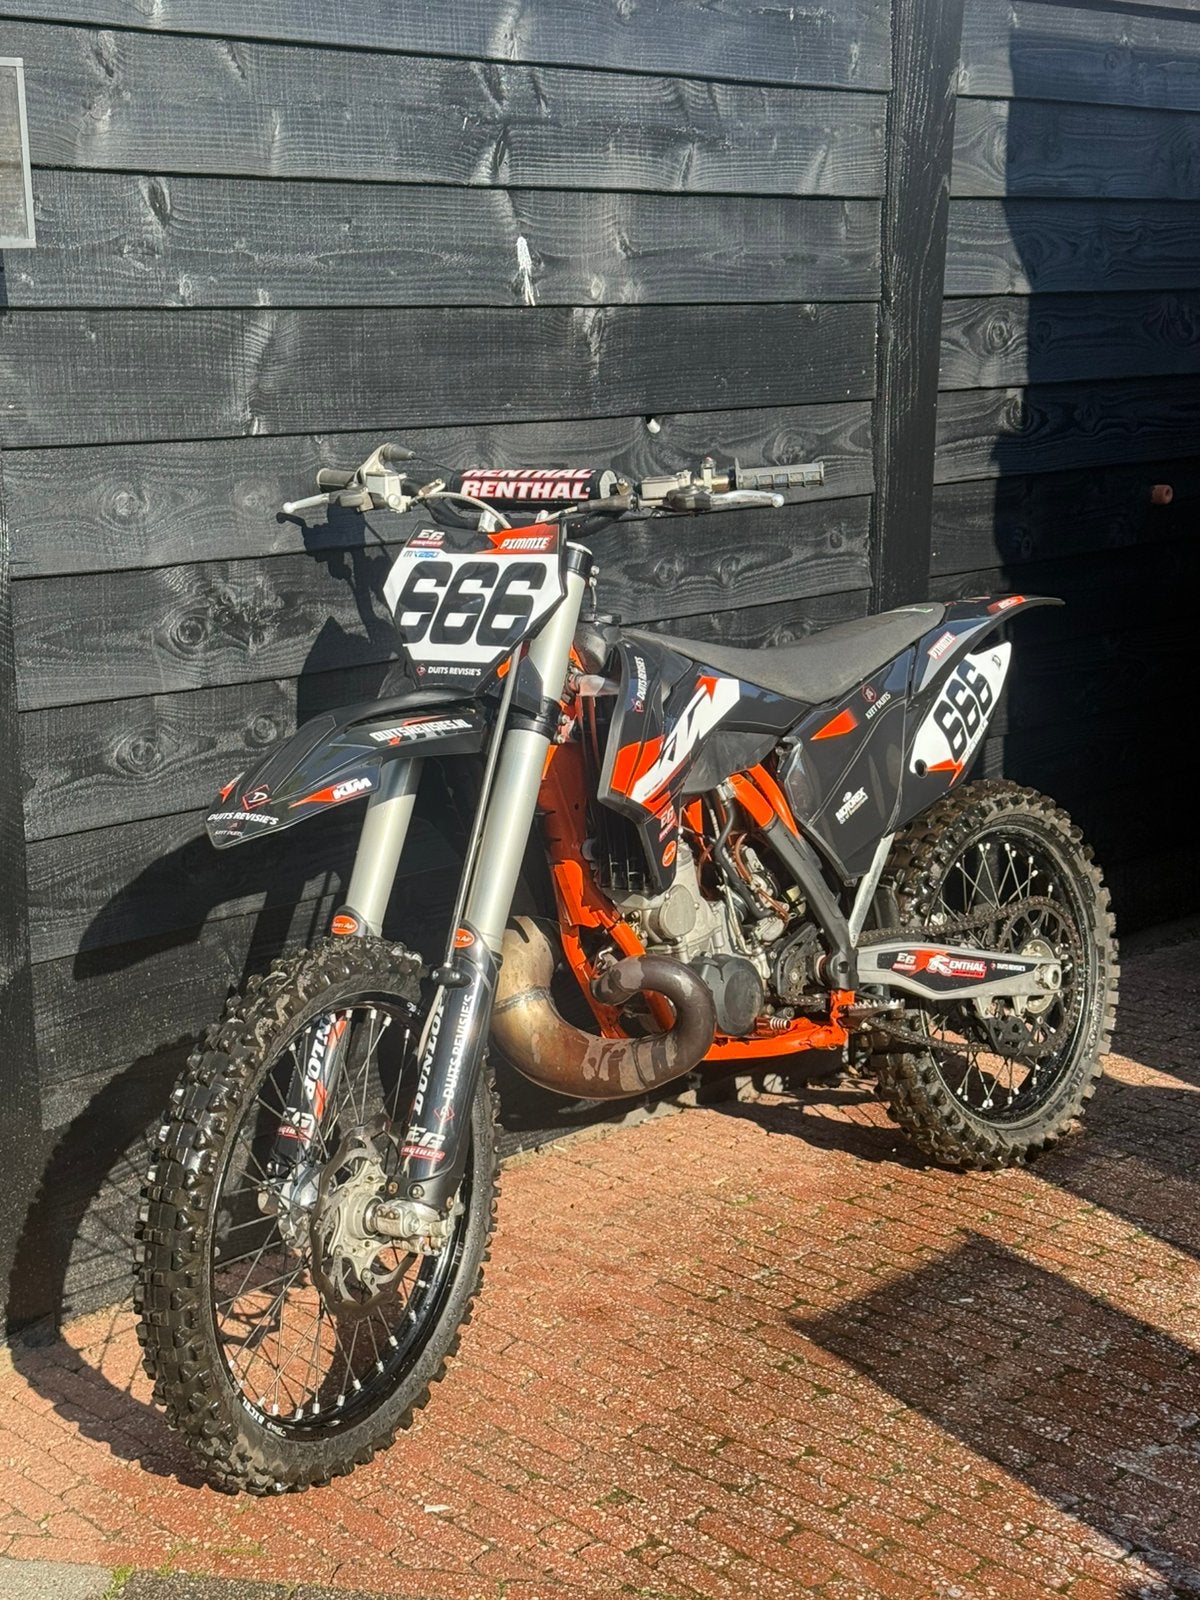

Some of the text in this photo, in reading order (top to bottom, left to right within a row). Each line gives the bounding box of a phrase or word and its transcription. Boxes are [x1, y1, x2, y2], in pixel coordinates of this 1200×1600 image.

[460, 480, 591, 499] RENTHAL
[394, 561, 547, 646] 666
[427, 666, 449, 674] DUITS
[933, 659, 993, 764] 666
[333, 777, 372, 800] KTM
[207, 812, 234, 821] DUITS
[443, 1058, 461, 1100] DUITS
